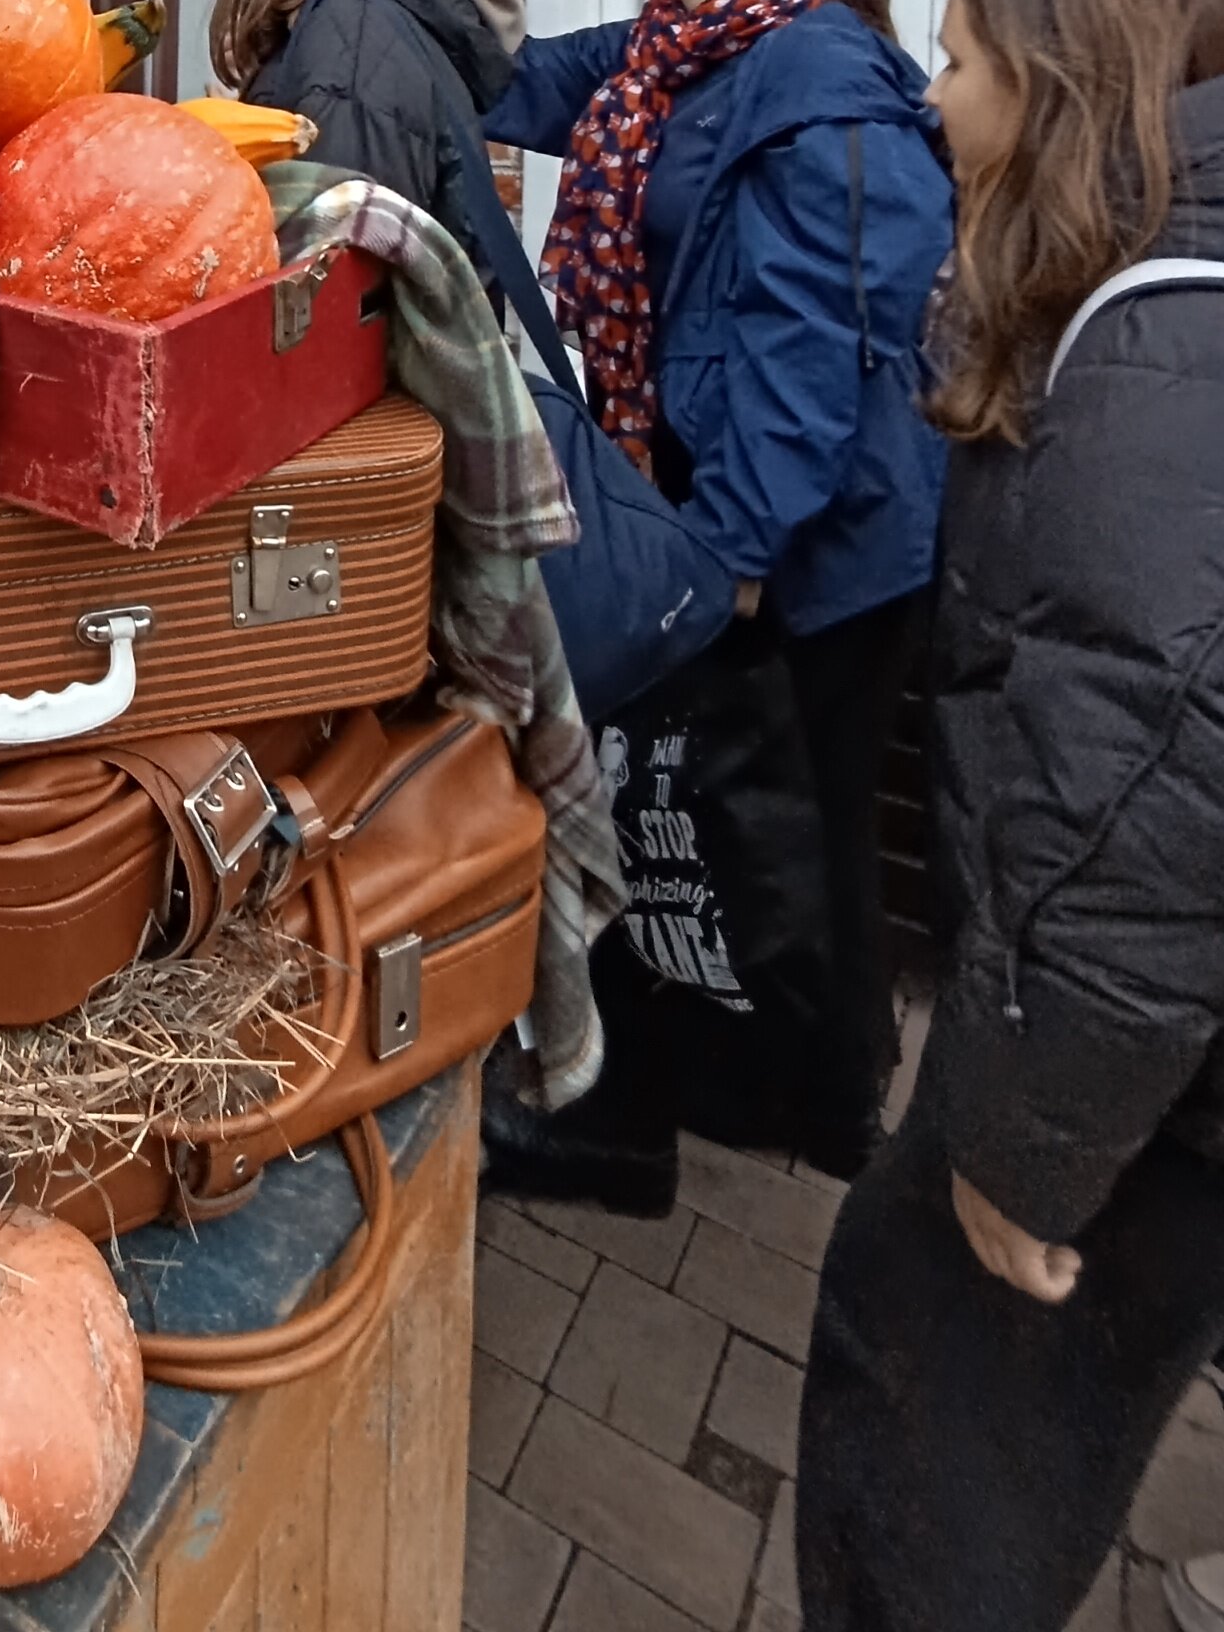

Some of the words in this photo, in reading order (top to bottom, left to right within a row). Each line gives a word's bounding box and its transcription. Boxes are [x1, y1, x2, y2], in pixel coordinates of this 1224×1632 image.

[654, 772, 671, 809] TO
[639, 810, 698, 861] STOP
[626, 873, 706, 915] phizing
